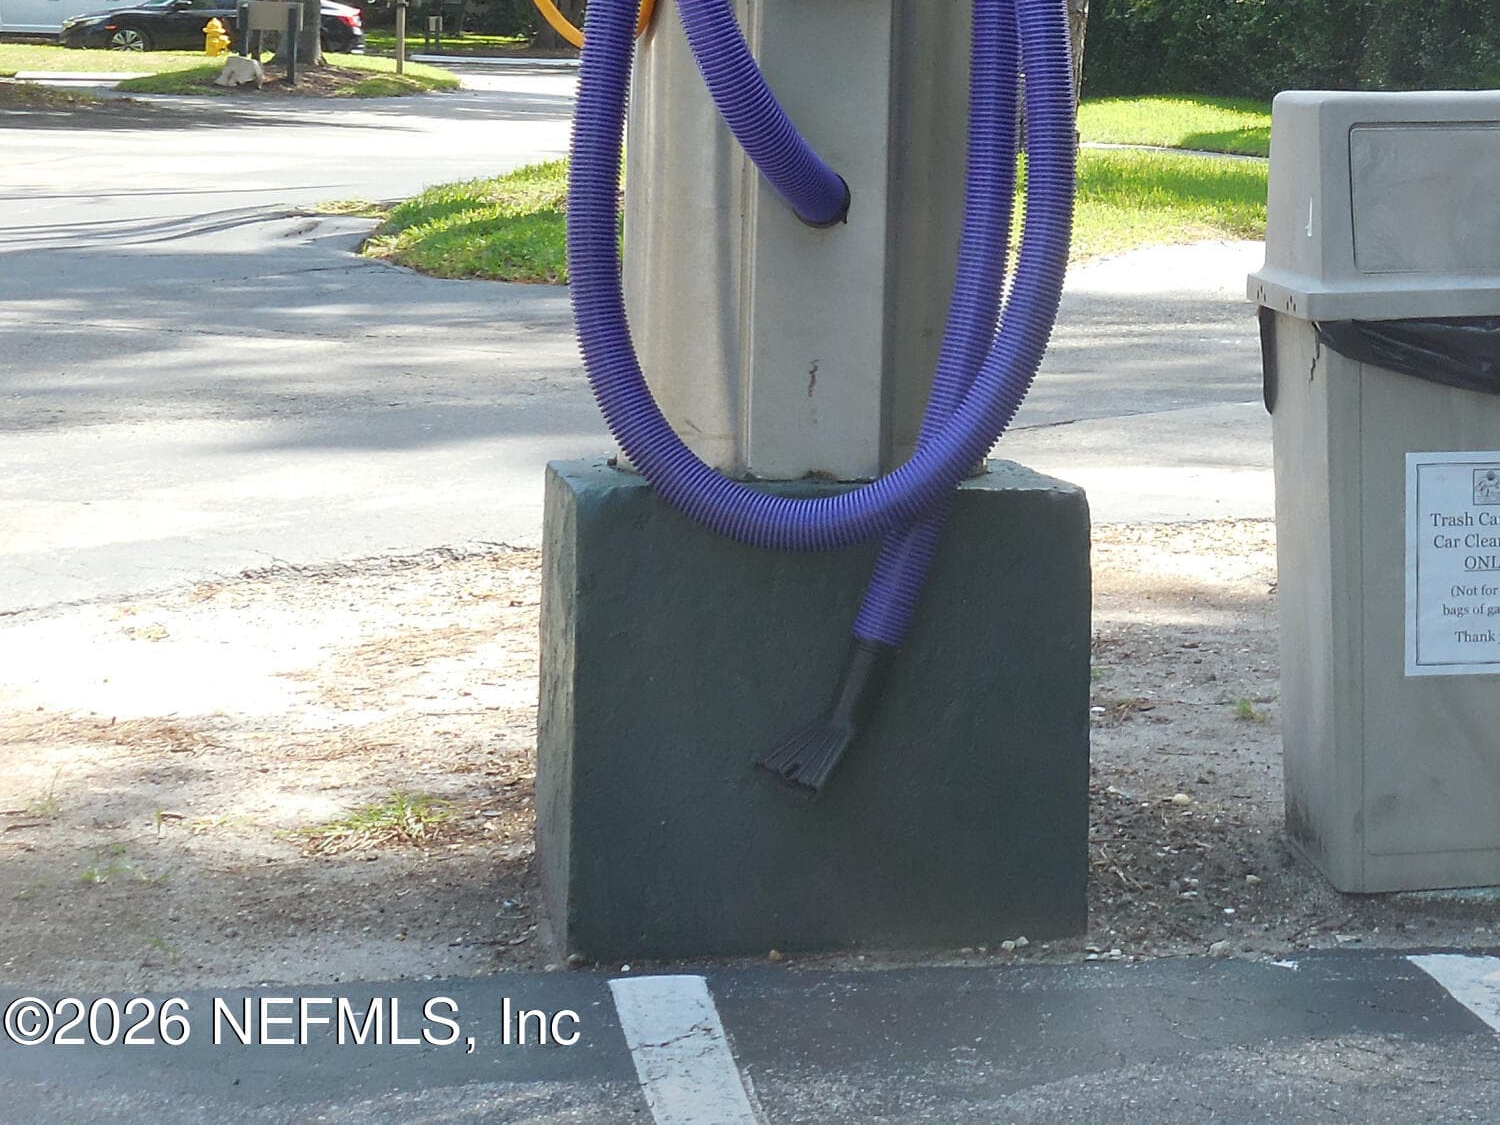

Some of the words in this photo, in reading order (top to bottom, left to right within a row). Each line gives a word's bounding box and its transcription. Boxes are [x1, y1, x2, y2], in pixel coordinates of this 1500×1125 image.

[1430, 511, 1474, 527] Trash
[1433, 534, 1460, 549] Car
[1450, 585, 1478, 597] (Not
[1481, 584, 1499, 596] for
[1442, 603, 1470, 618] bags
[1472, 603, 1485, 615] of
[1454, 630, 1496, 643] Thank
